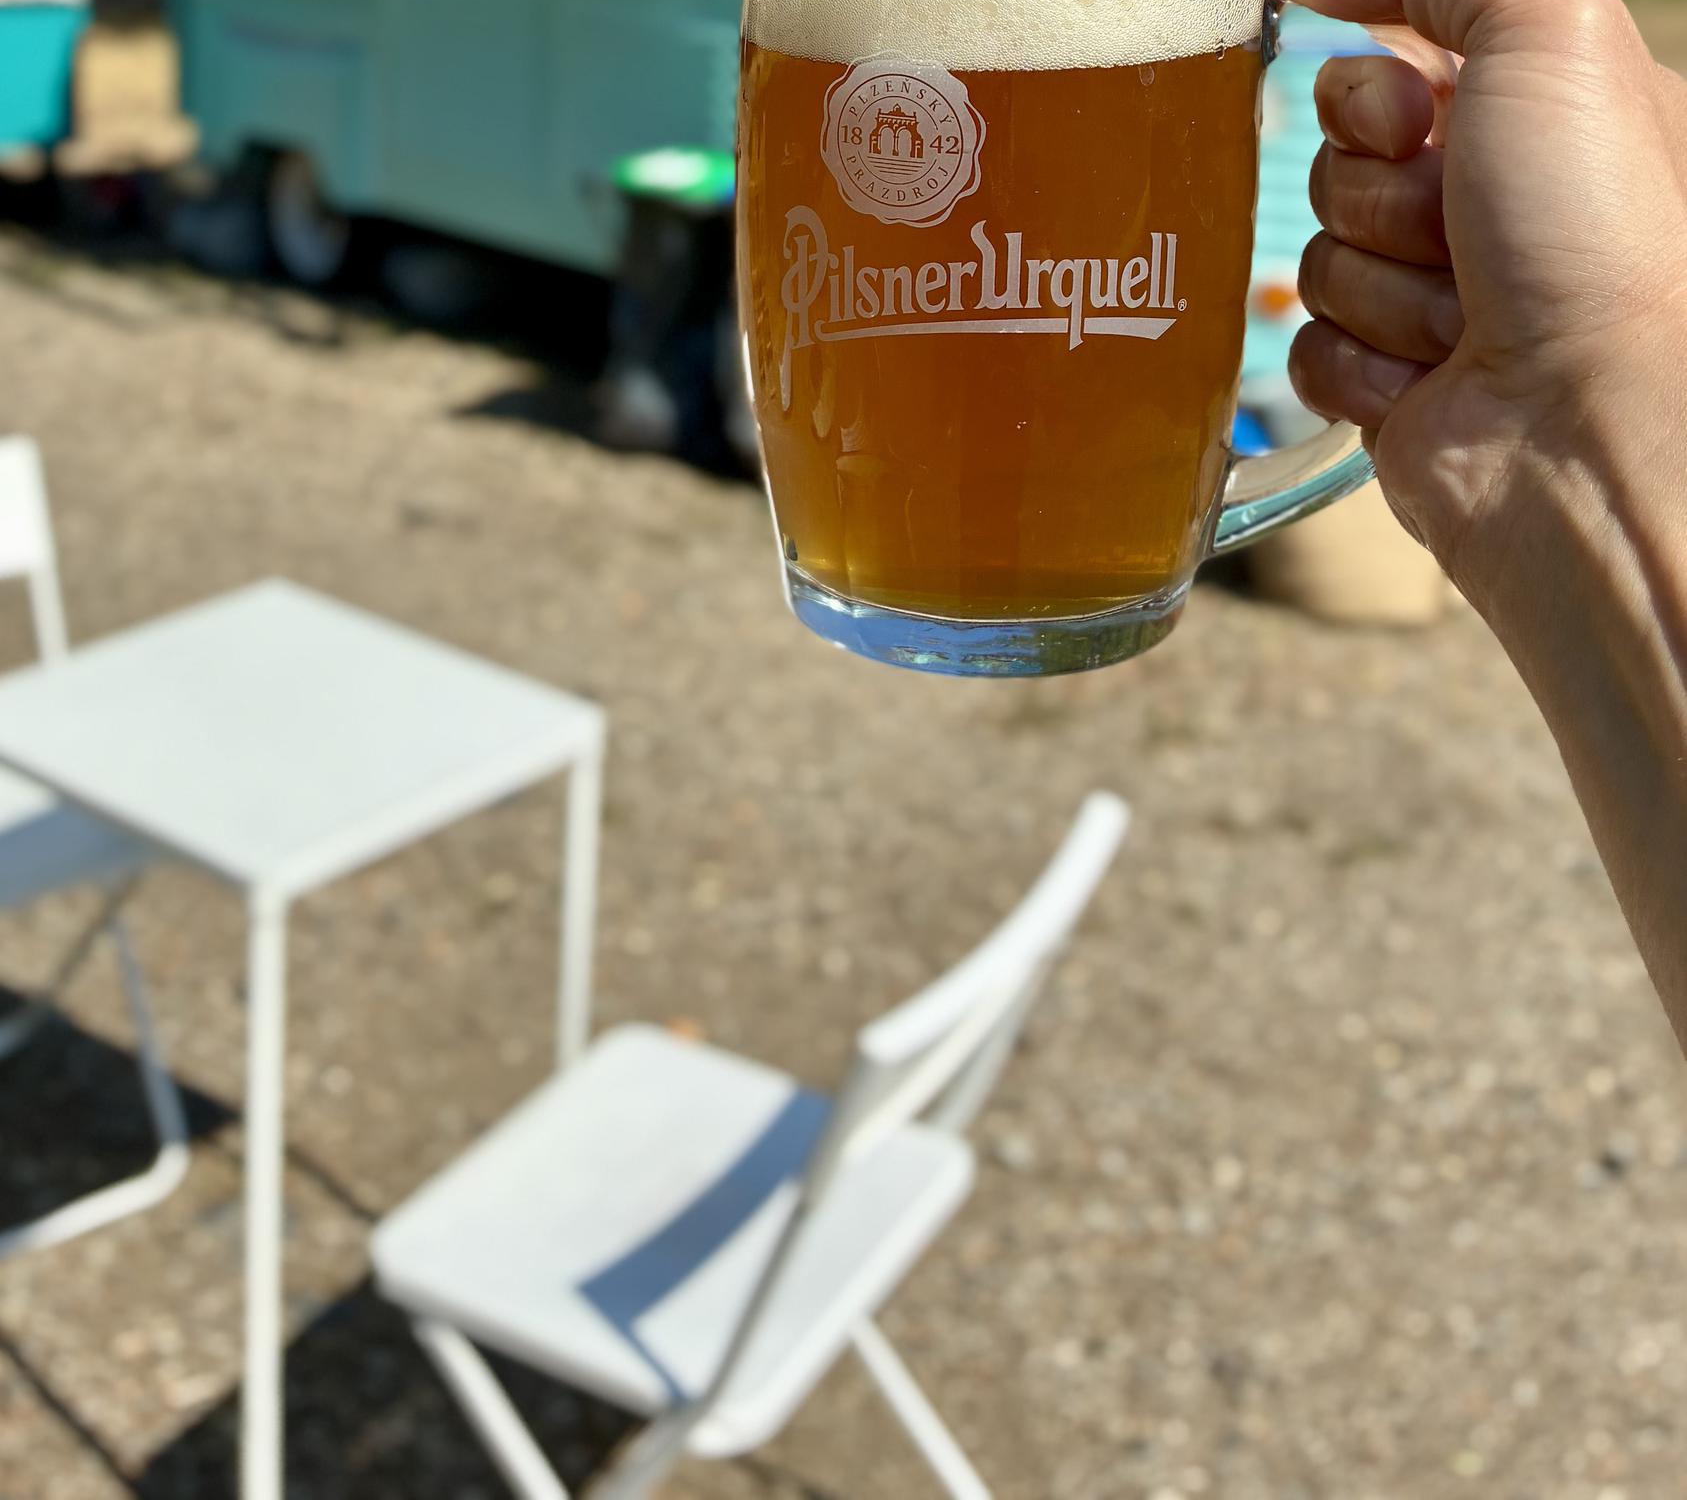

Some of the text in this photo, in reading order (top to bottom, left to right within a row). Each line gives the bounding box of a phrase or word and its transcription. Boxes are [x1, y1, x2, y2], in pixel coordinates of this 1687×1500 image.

[848, 78, 955, 125] PLZEŇSKÝ
[841, 125, 863, 145] 18
[929, 135, 960, 155] 42
[846, 155, 950, 202] PRAZDROJ
[780, 205, 978, 350] Pilsner
